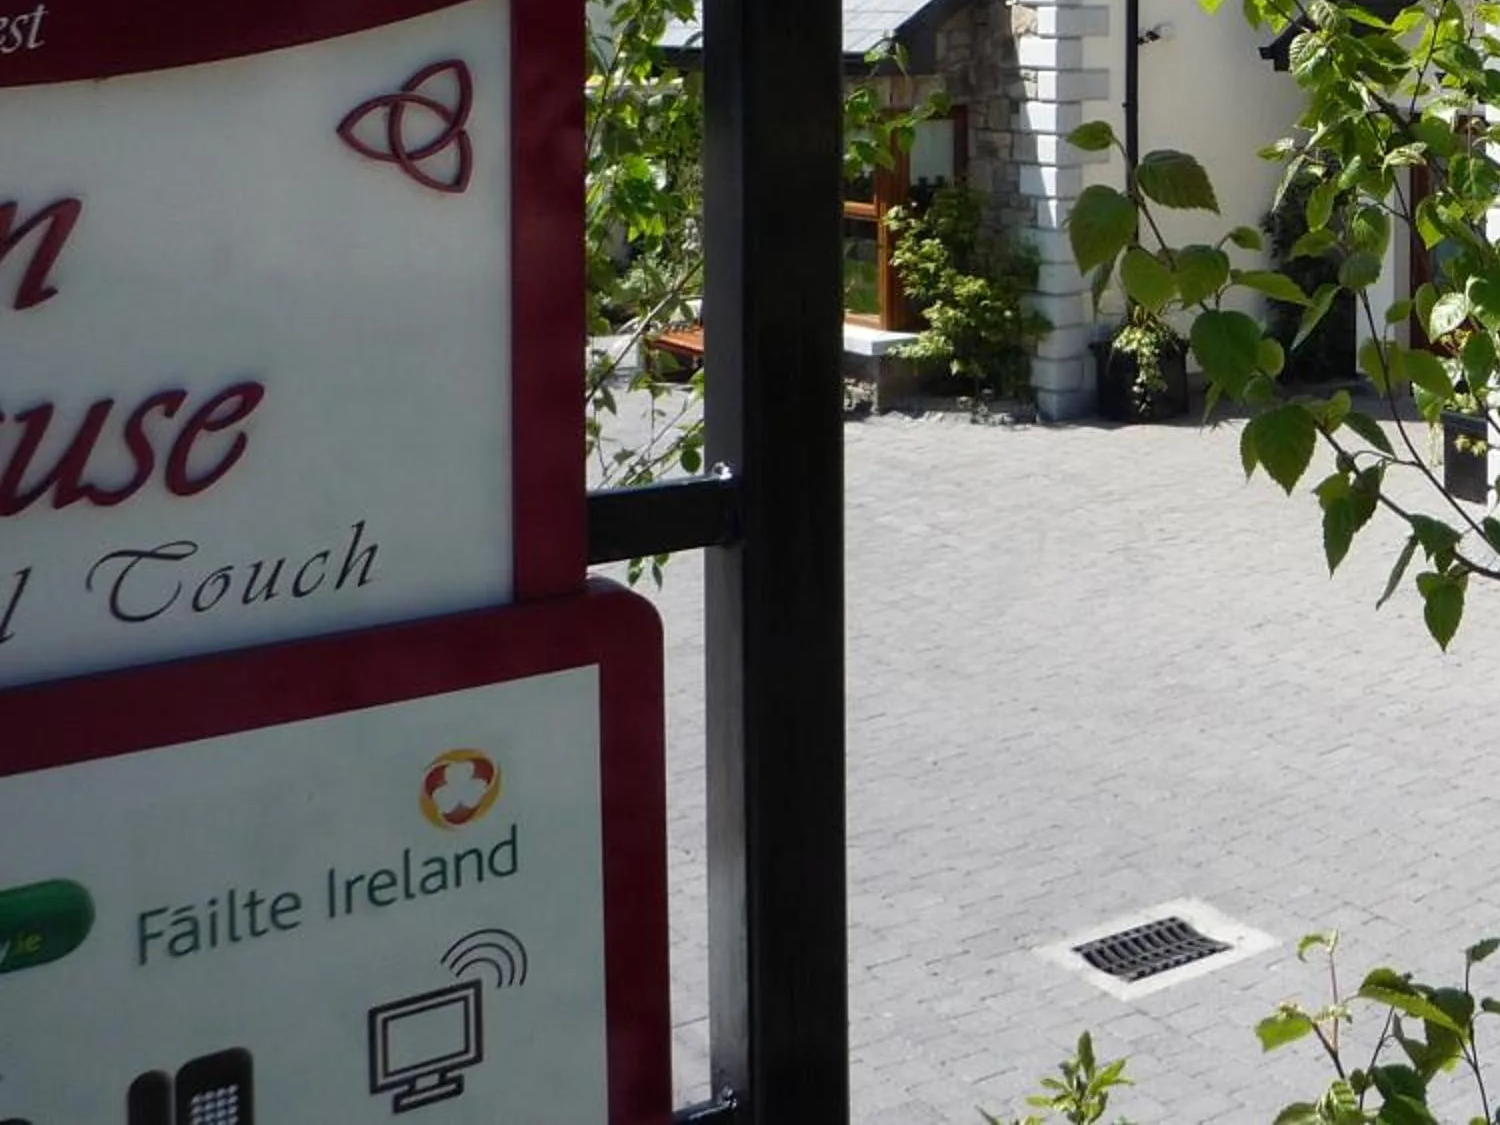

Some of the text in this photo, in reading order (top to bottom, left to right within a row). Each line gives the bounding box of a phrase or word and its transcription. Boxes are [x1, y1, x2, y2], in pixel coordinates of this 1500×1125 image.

[0, 380, 265, 517] use
[85, 519, 379, 623] Touch
[328, 824, 518, 919] Ireland
